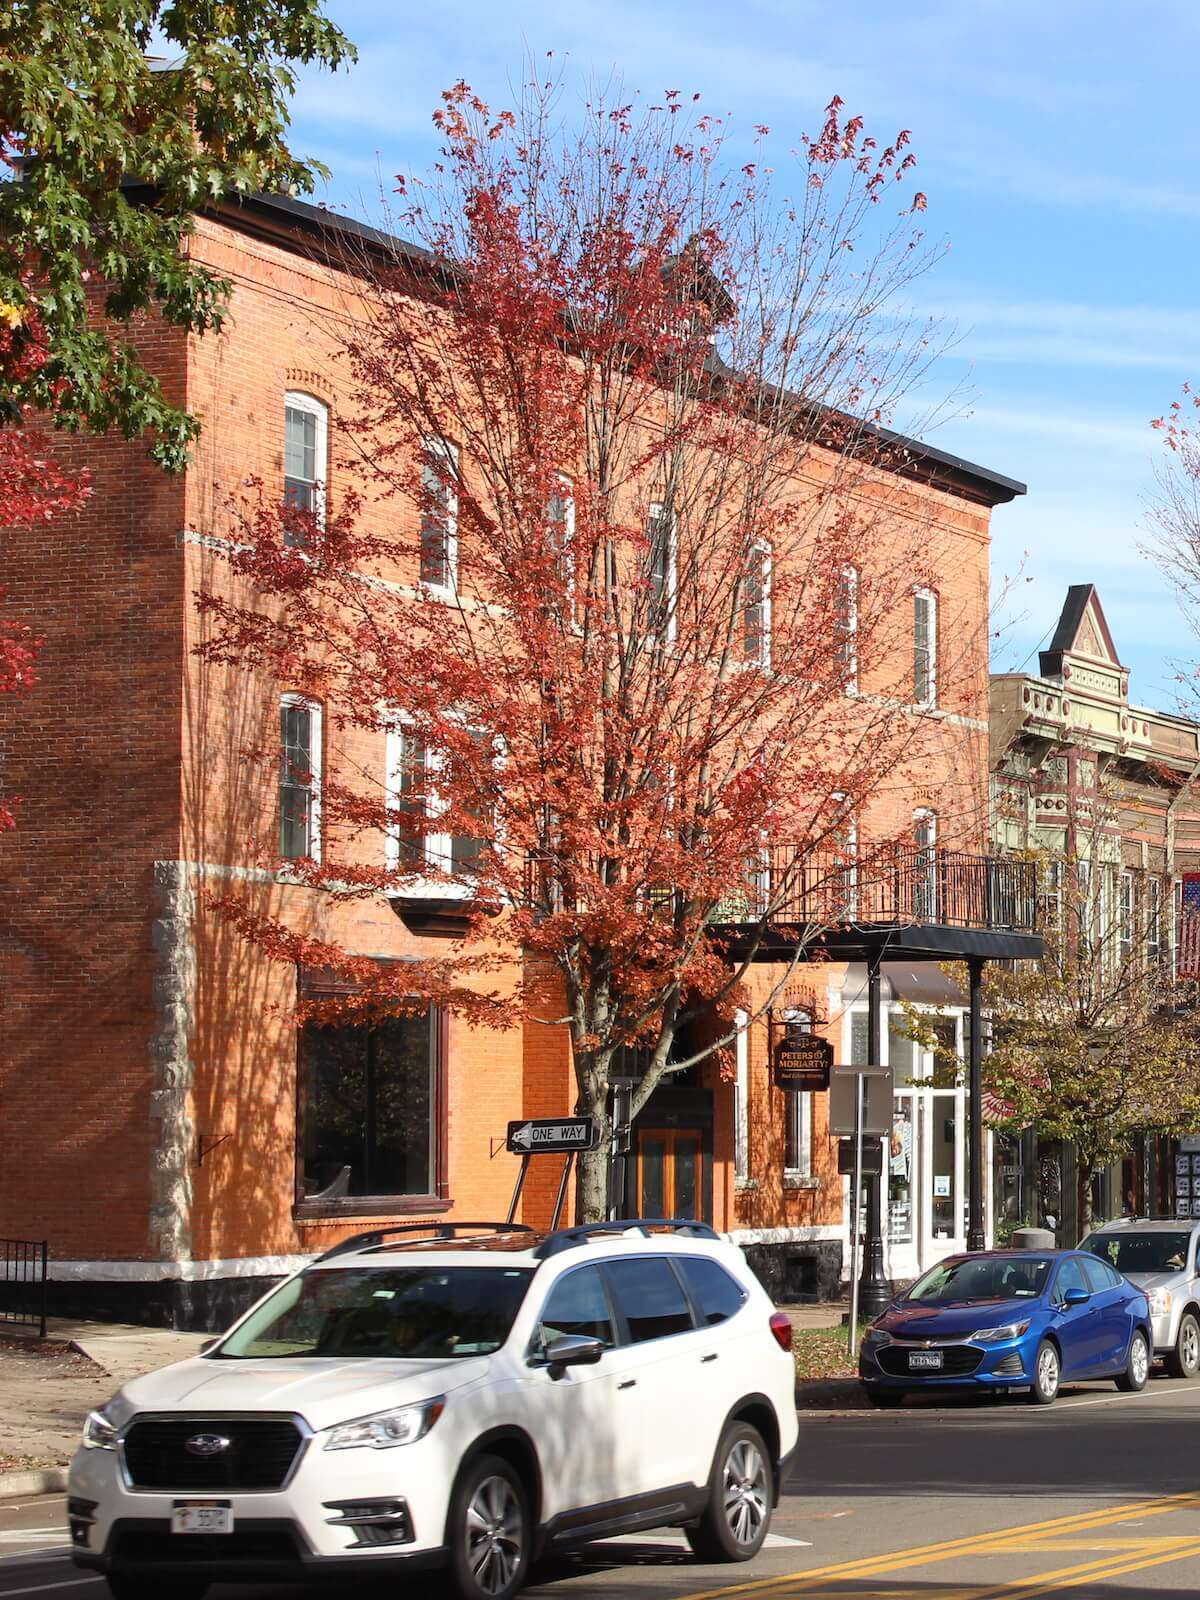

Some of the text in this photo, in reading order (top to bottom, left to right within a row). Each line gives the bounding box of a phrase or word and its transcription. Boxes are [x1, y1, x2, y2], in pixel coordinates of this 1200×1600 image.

[781, 1051, 813, 1060] PETERS
[779, 1060, 825, 1068] MORIARTY
[532, 1126, 583, 1140] ONE WAY
